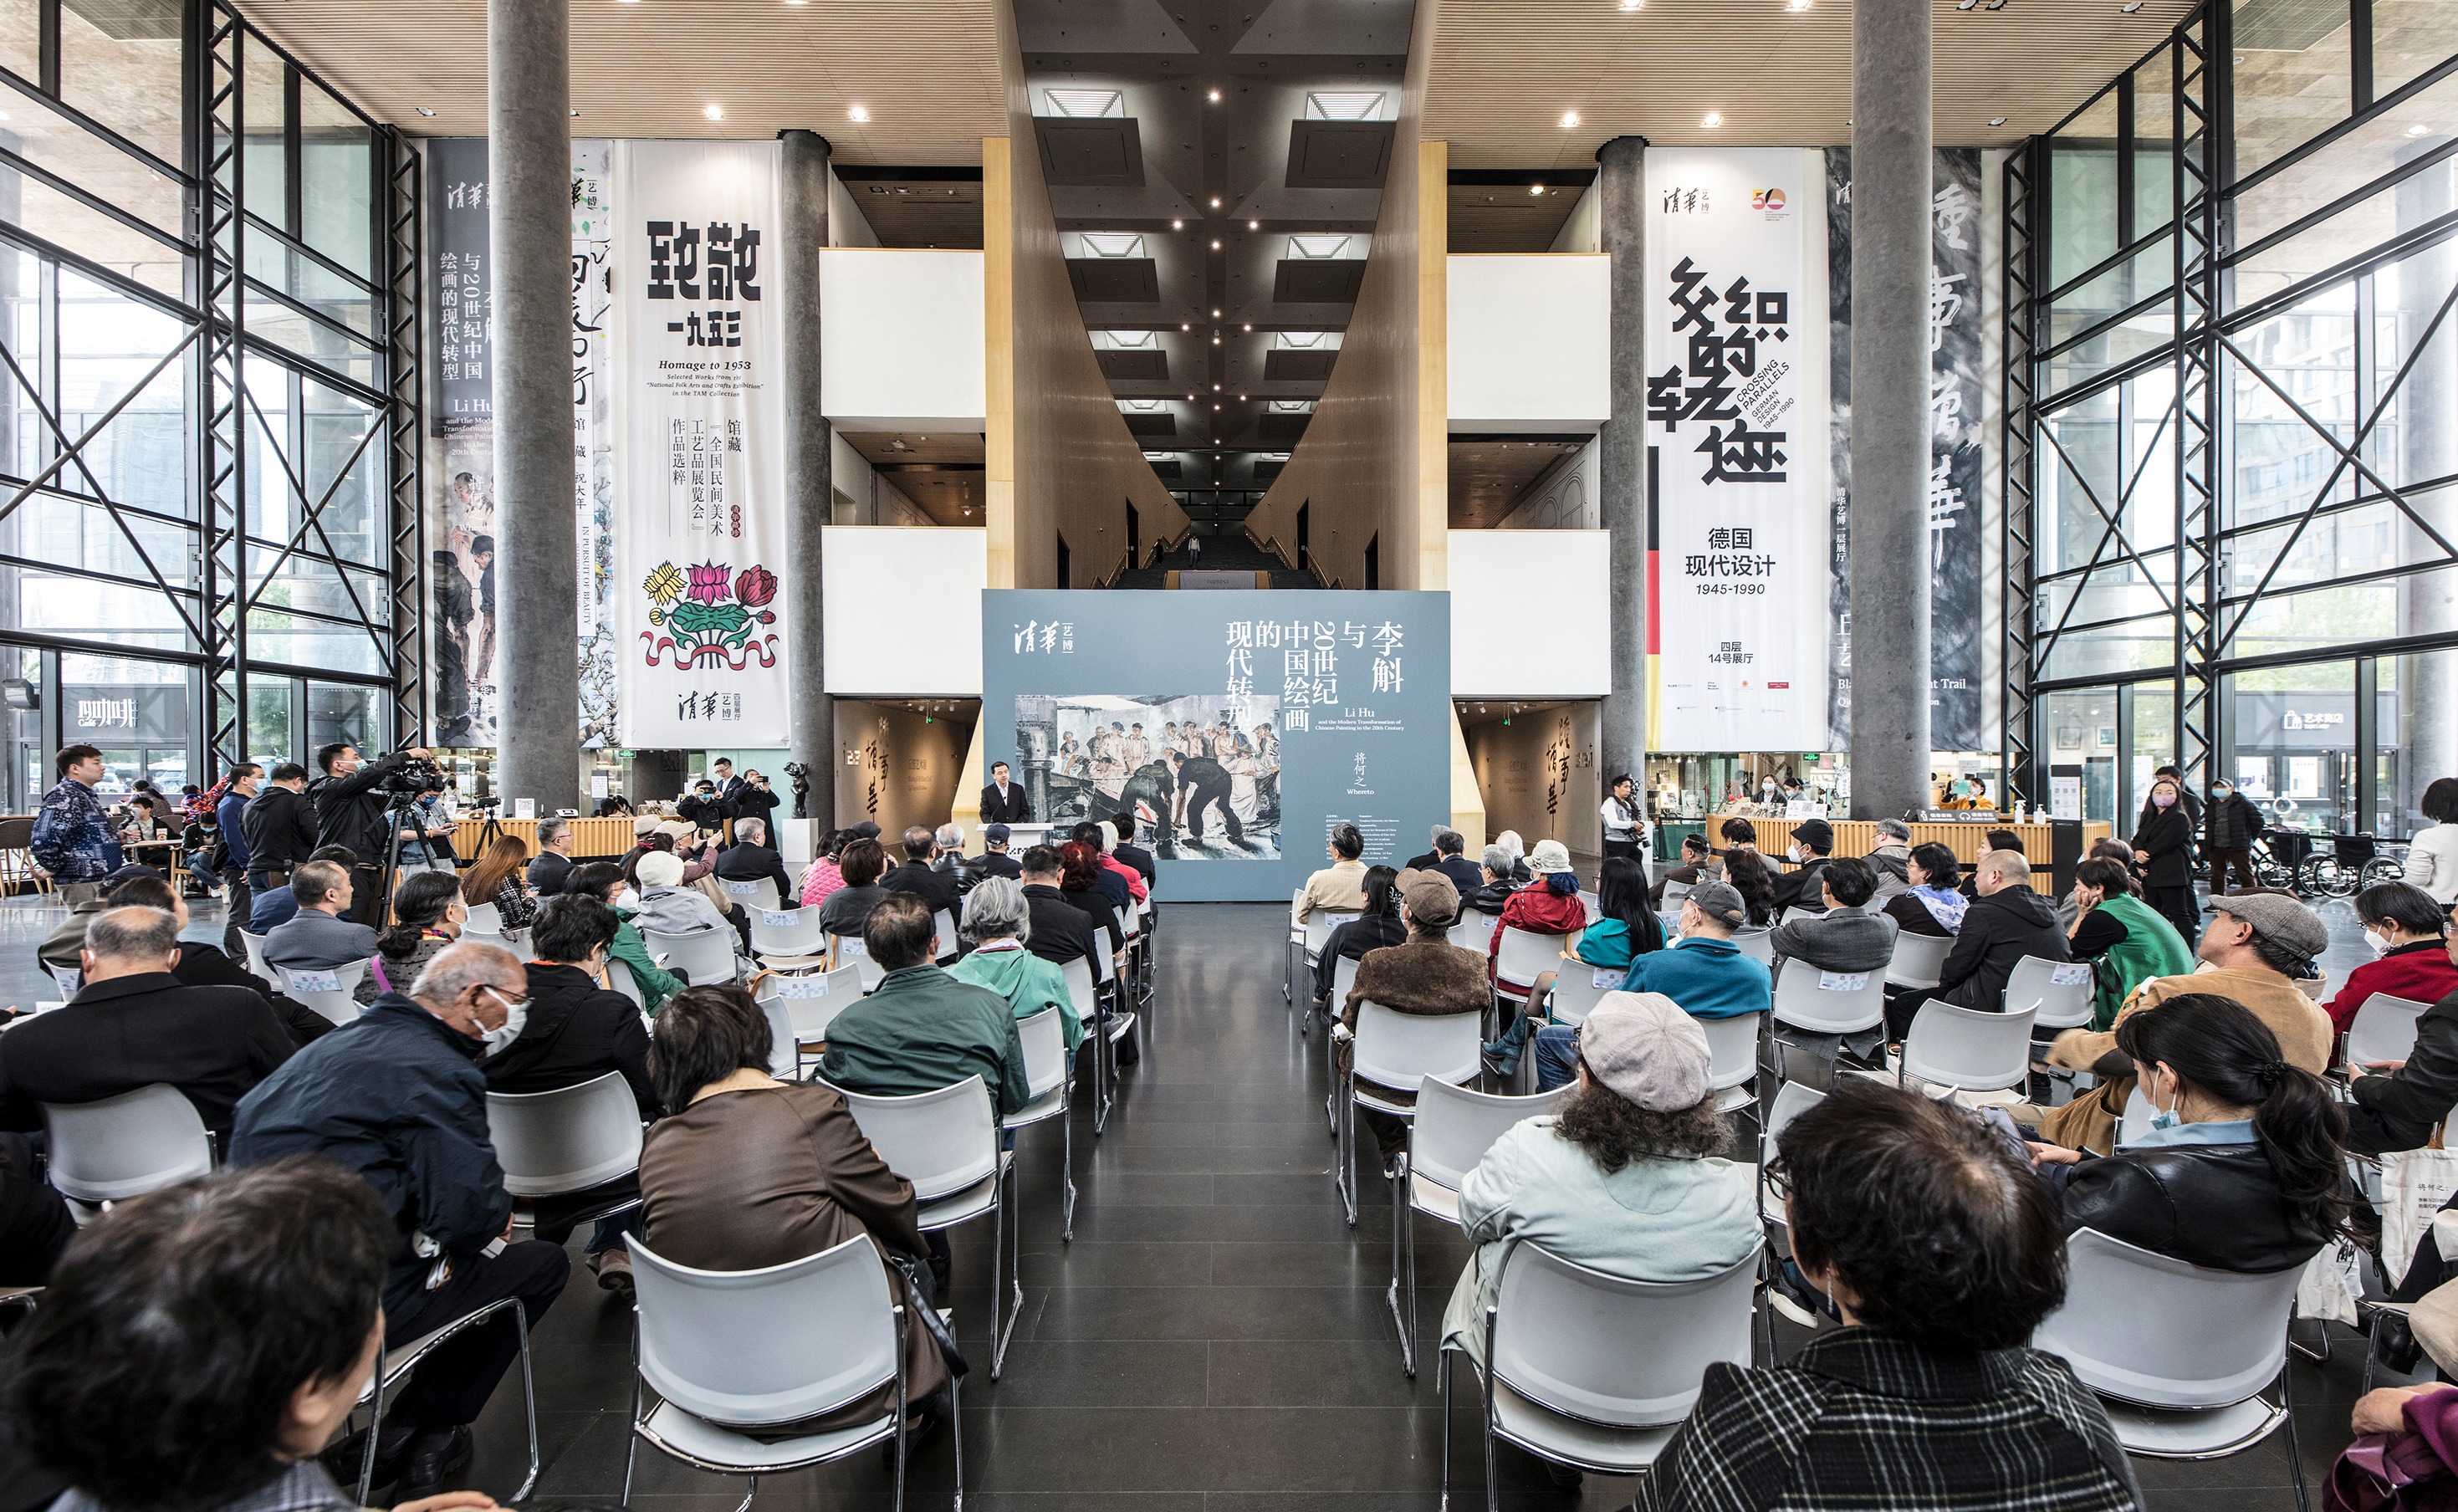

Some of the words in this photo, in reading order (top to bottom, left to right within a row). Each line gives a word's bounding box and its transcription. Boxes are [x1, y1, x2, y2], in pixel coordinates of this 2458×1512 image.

[646, 221, 761, 302] 致敬
[440, 252, 460, 381] 绘画的现代转型
[462, 253, 483, 380] 与20世纪中国
[667, 311, 741, 347] 一九五三
[658, 360, 706, 371] Homage
[710, 361, 720, 370] to
[724, 360, 752, 370] 1953
[1736, 359, 1778, 402] CROSSING
[1742, 361, 1790, 410] PARALLELS
[454, 399, 469, 412] Li
[473, 399, 493, 412] Hu
[1751, 389, 1779, 417] GERMAN
[1757, 398, 1781, 423] DESIGN
[728, 419, 742, 452] 馆藏
[672, 418, 686, 486] 作品选粹
[582, 526, 590, 536] IN
[1708, 528, 1753, 550] 德国
[1836, 487, 1847, 563] 清华艺博一层展厅
[1685, 554, 1776, 577] 现代设计
[583, 577, 590, 590] OF
[1696, 584, 1766, 595] 1945-1990
[1255, 620, 1281, 648] 的
[1340, 621, 1367, 649] 与
[1720, 641, 1742, 652] 四层
[1311, 621, 1339, 705] 20世纪
[1372, 621, 1405, 693] 李斛
[1708, 653, 1754, 664] 14号展厅
[1225, 620, 1254, 733] 现代转型
[1284, 620, 1311, 733] 中国绘画
[1940, 678, 1966, 689] Trail
[1345, 707, 1356, 718] Li
[1358, 707, 1375, 718] Hu
[1353, 752, 1367, 787] 将何之
